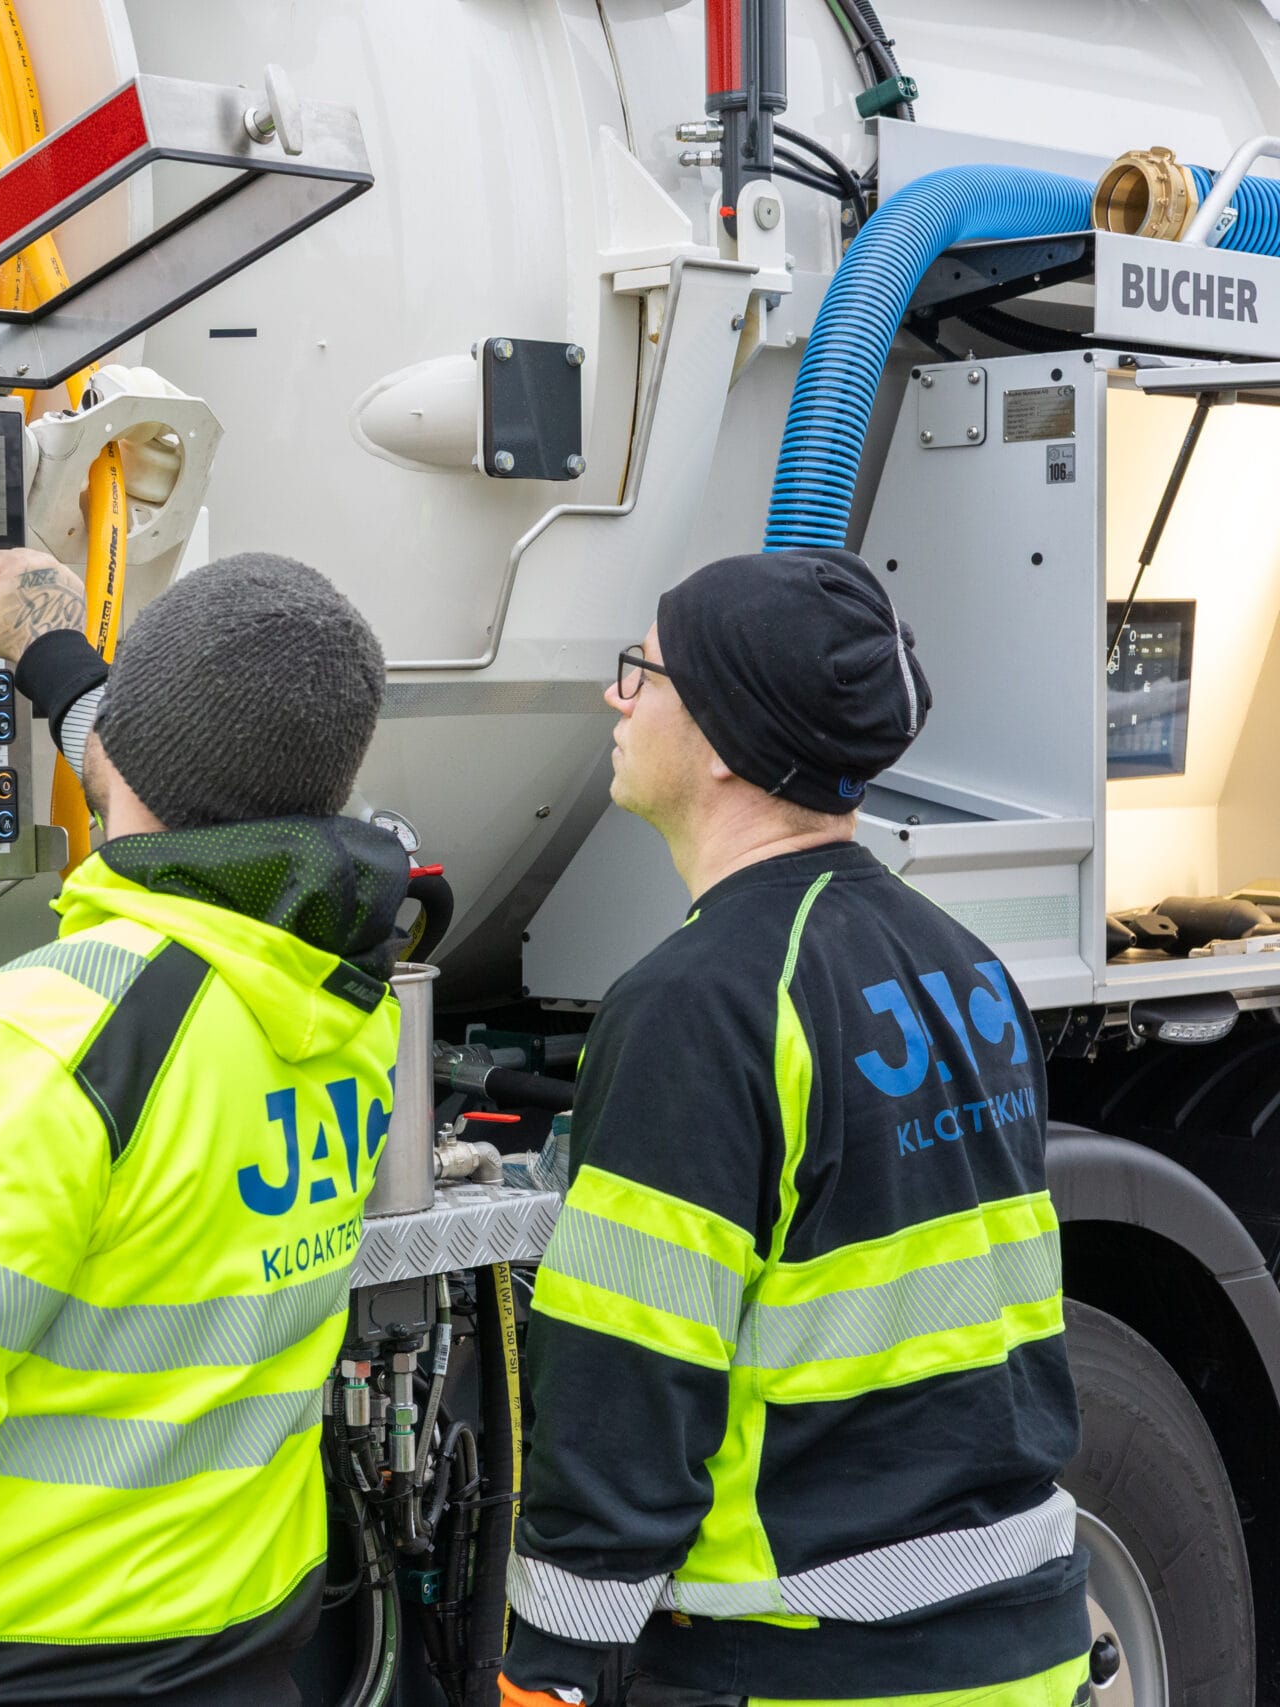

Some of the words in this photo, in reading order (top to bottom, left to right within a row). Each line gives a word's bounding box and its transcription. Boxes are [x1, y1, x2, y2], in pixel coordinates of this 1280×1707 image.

[1122, 262, 1259, 324] BUCHER
[1049, 462, 1066, 481] 106
[498, 1262, 508, 1284] AR
[506, 1323, 515, 1345] 150
[509, 1348, 518, 1374] PSI)
